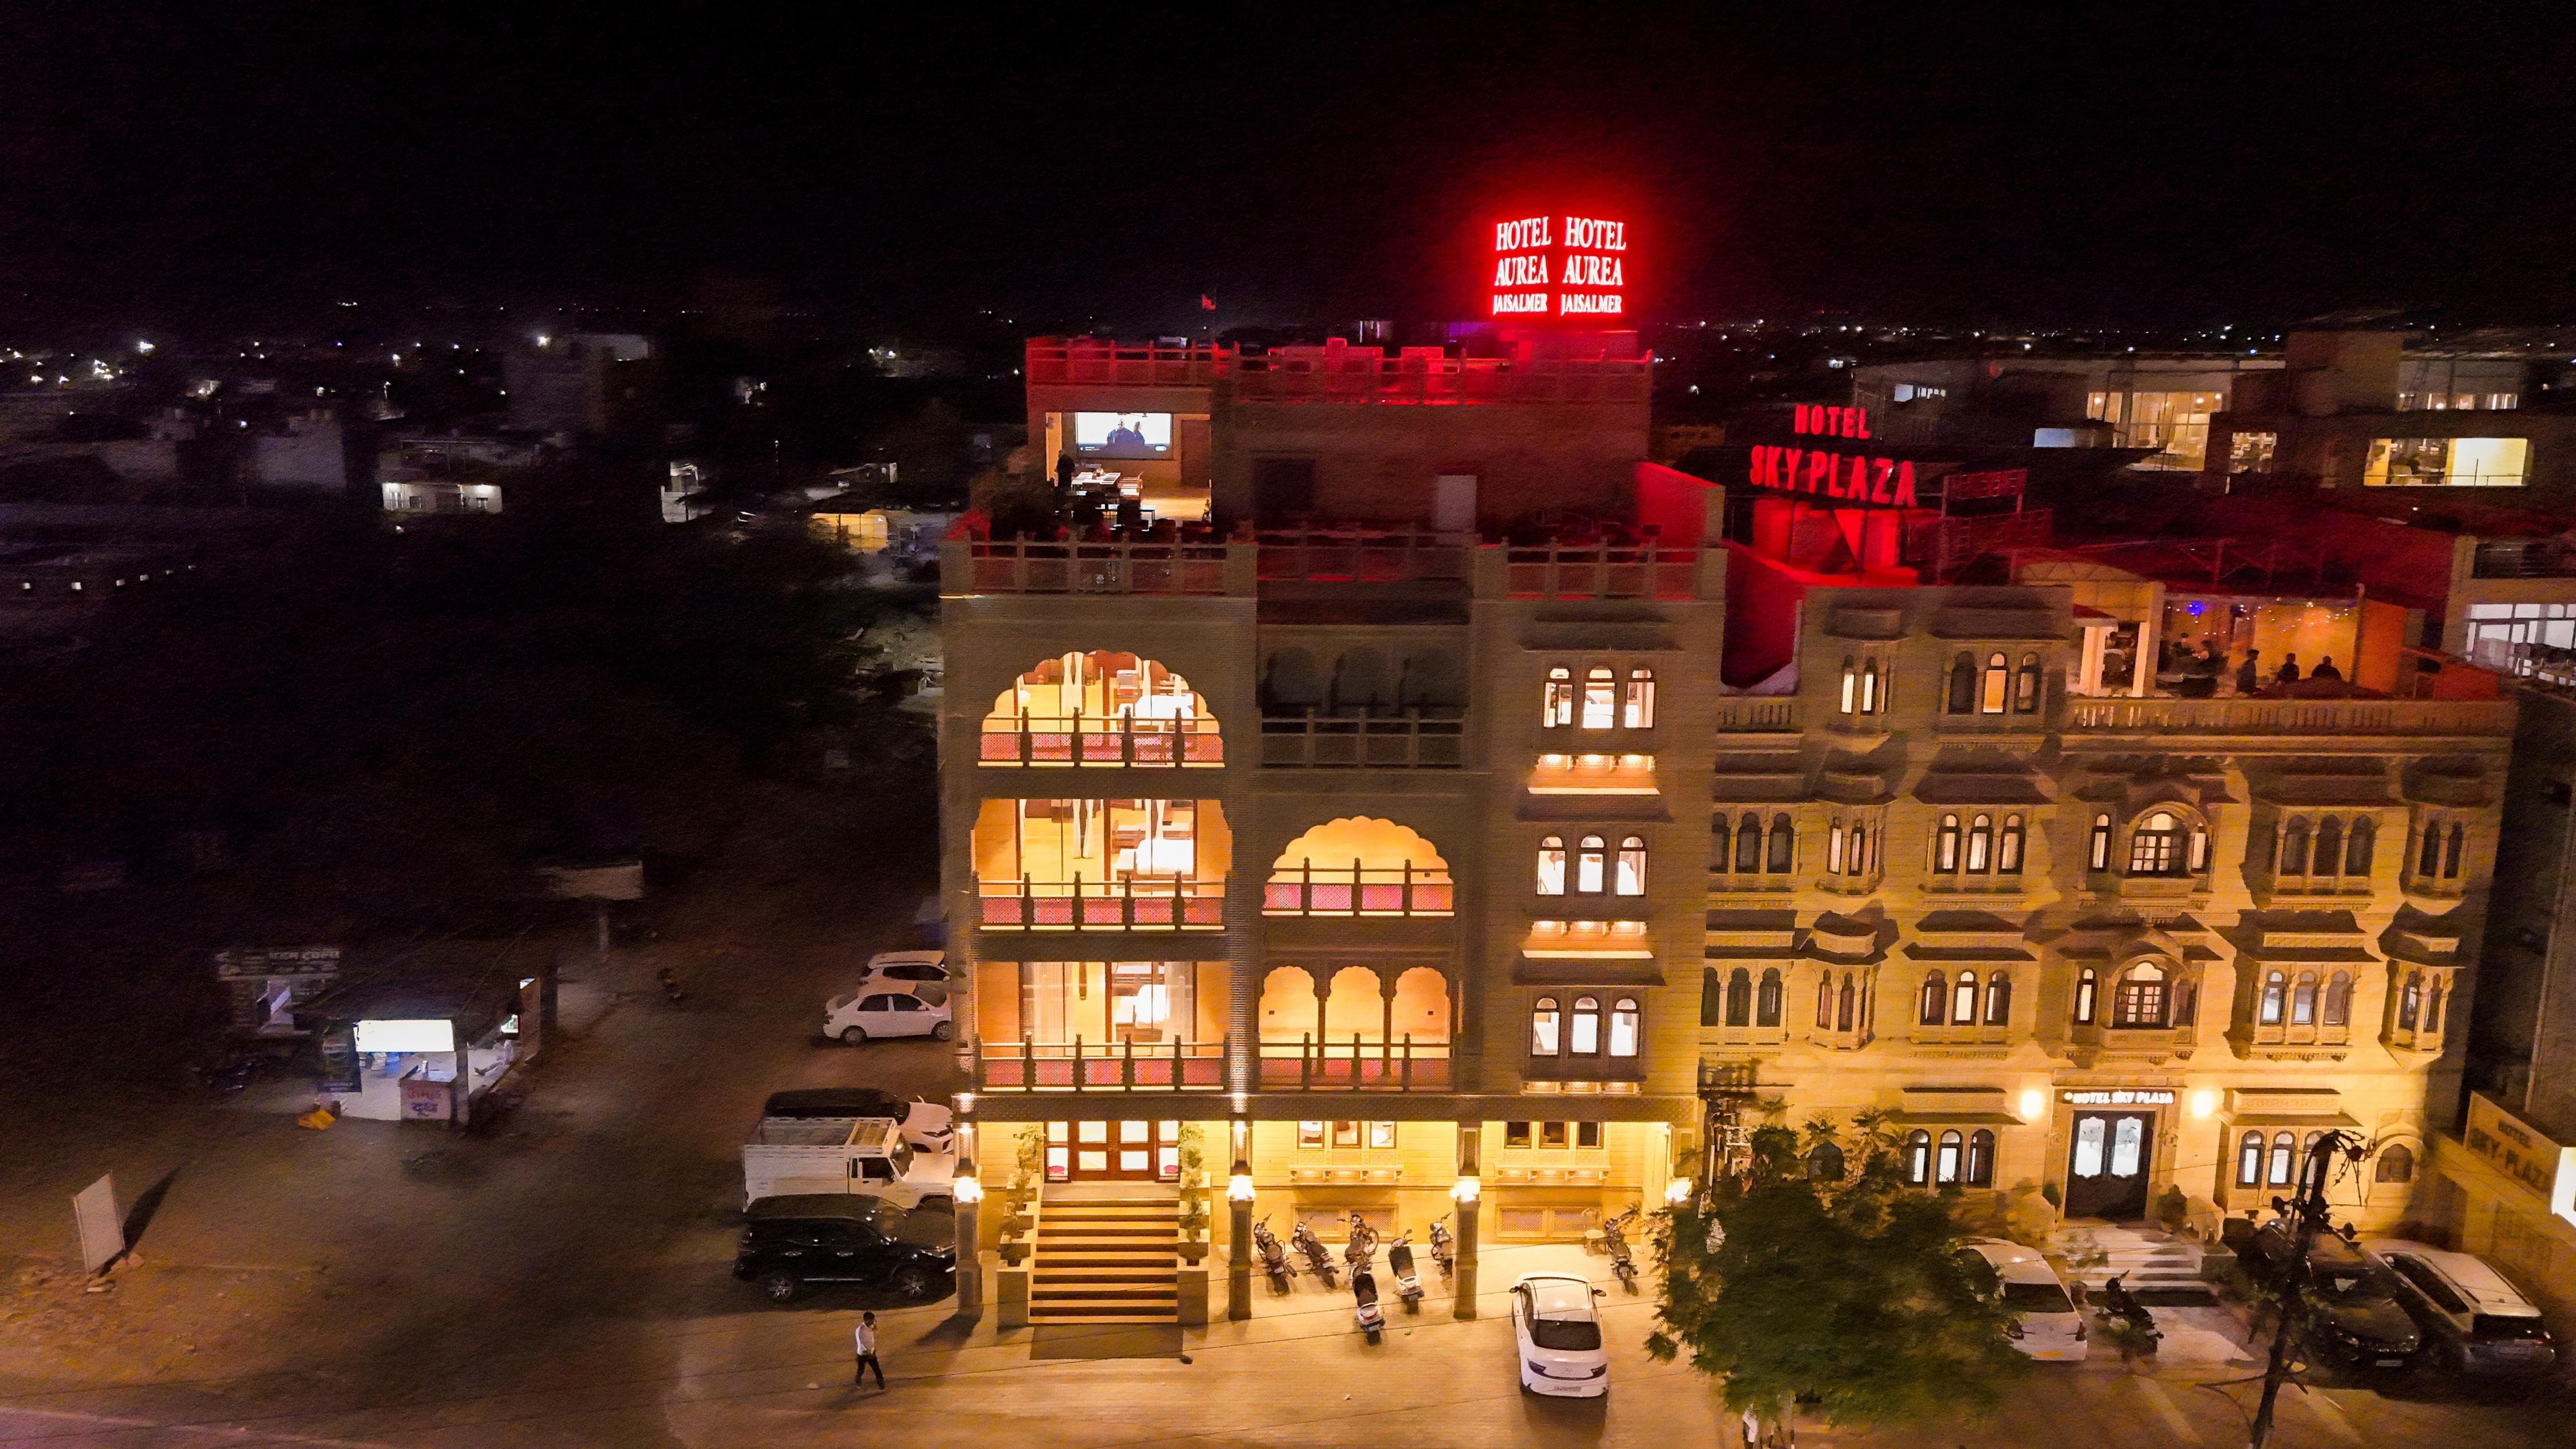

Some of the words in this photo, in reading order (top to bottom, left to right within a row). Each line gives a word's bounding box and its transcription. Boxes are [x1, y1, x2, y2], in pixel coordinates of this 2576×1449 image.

[1496, 216, 1552, 251] HOTEL
[1564, 216, 1626, 250] HOTEL
[1495, 255, 1549, 286] AUREA
[1562, 255, 1623, 286] AUREA
[1493, 293, 1548, 315] JAISALMER
[1560, 294, 1622, 316] JAISALMER
[1795, 404, 1870, 439] HOTEL
[1750, 445, 1802, 491] SKY
[1808, 451, 1916, 507] PLAZA
[2072, 1092, 2111, 1104] HOTEL
[2112, 1091, 2135, 1104] SKY
[2136, 1092, 2174, 1104] PLAZA
